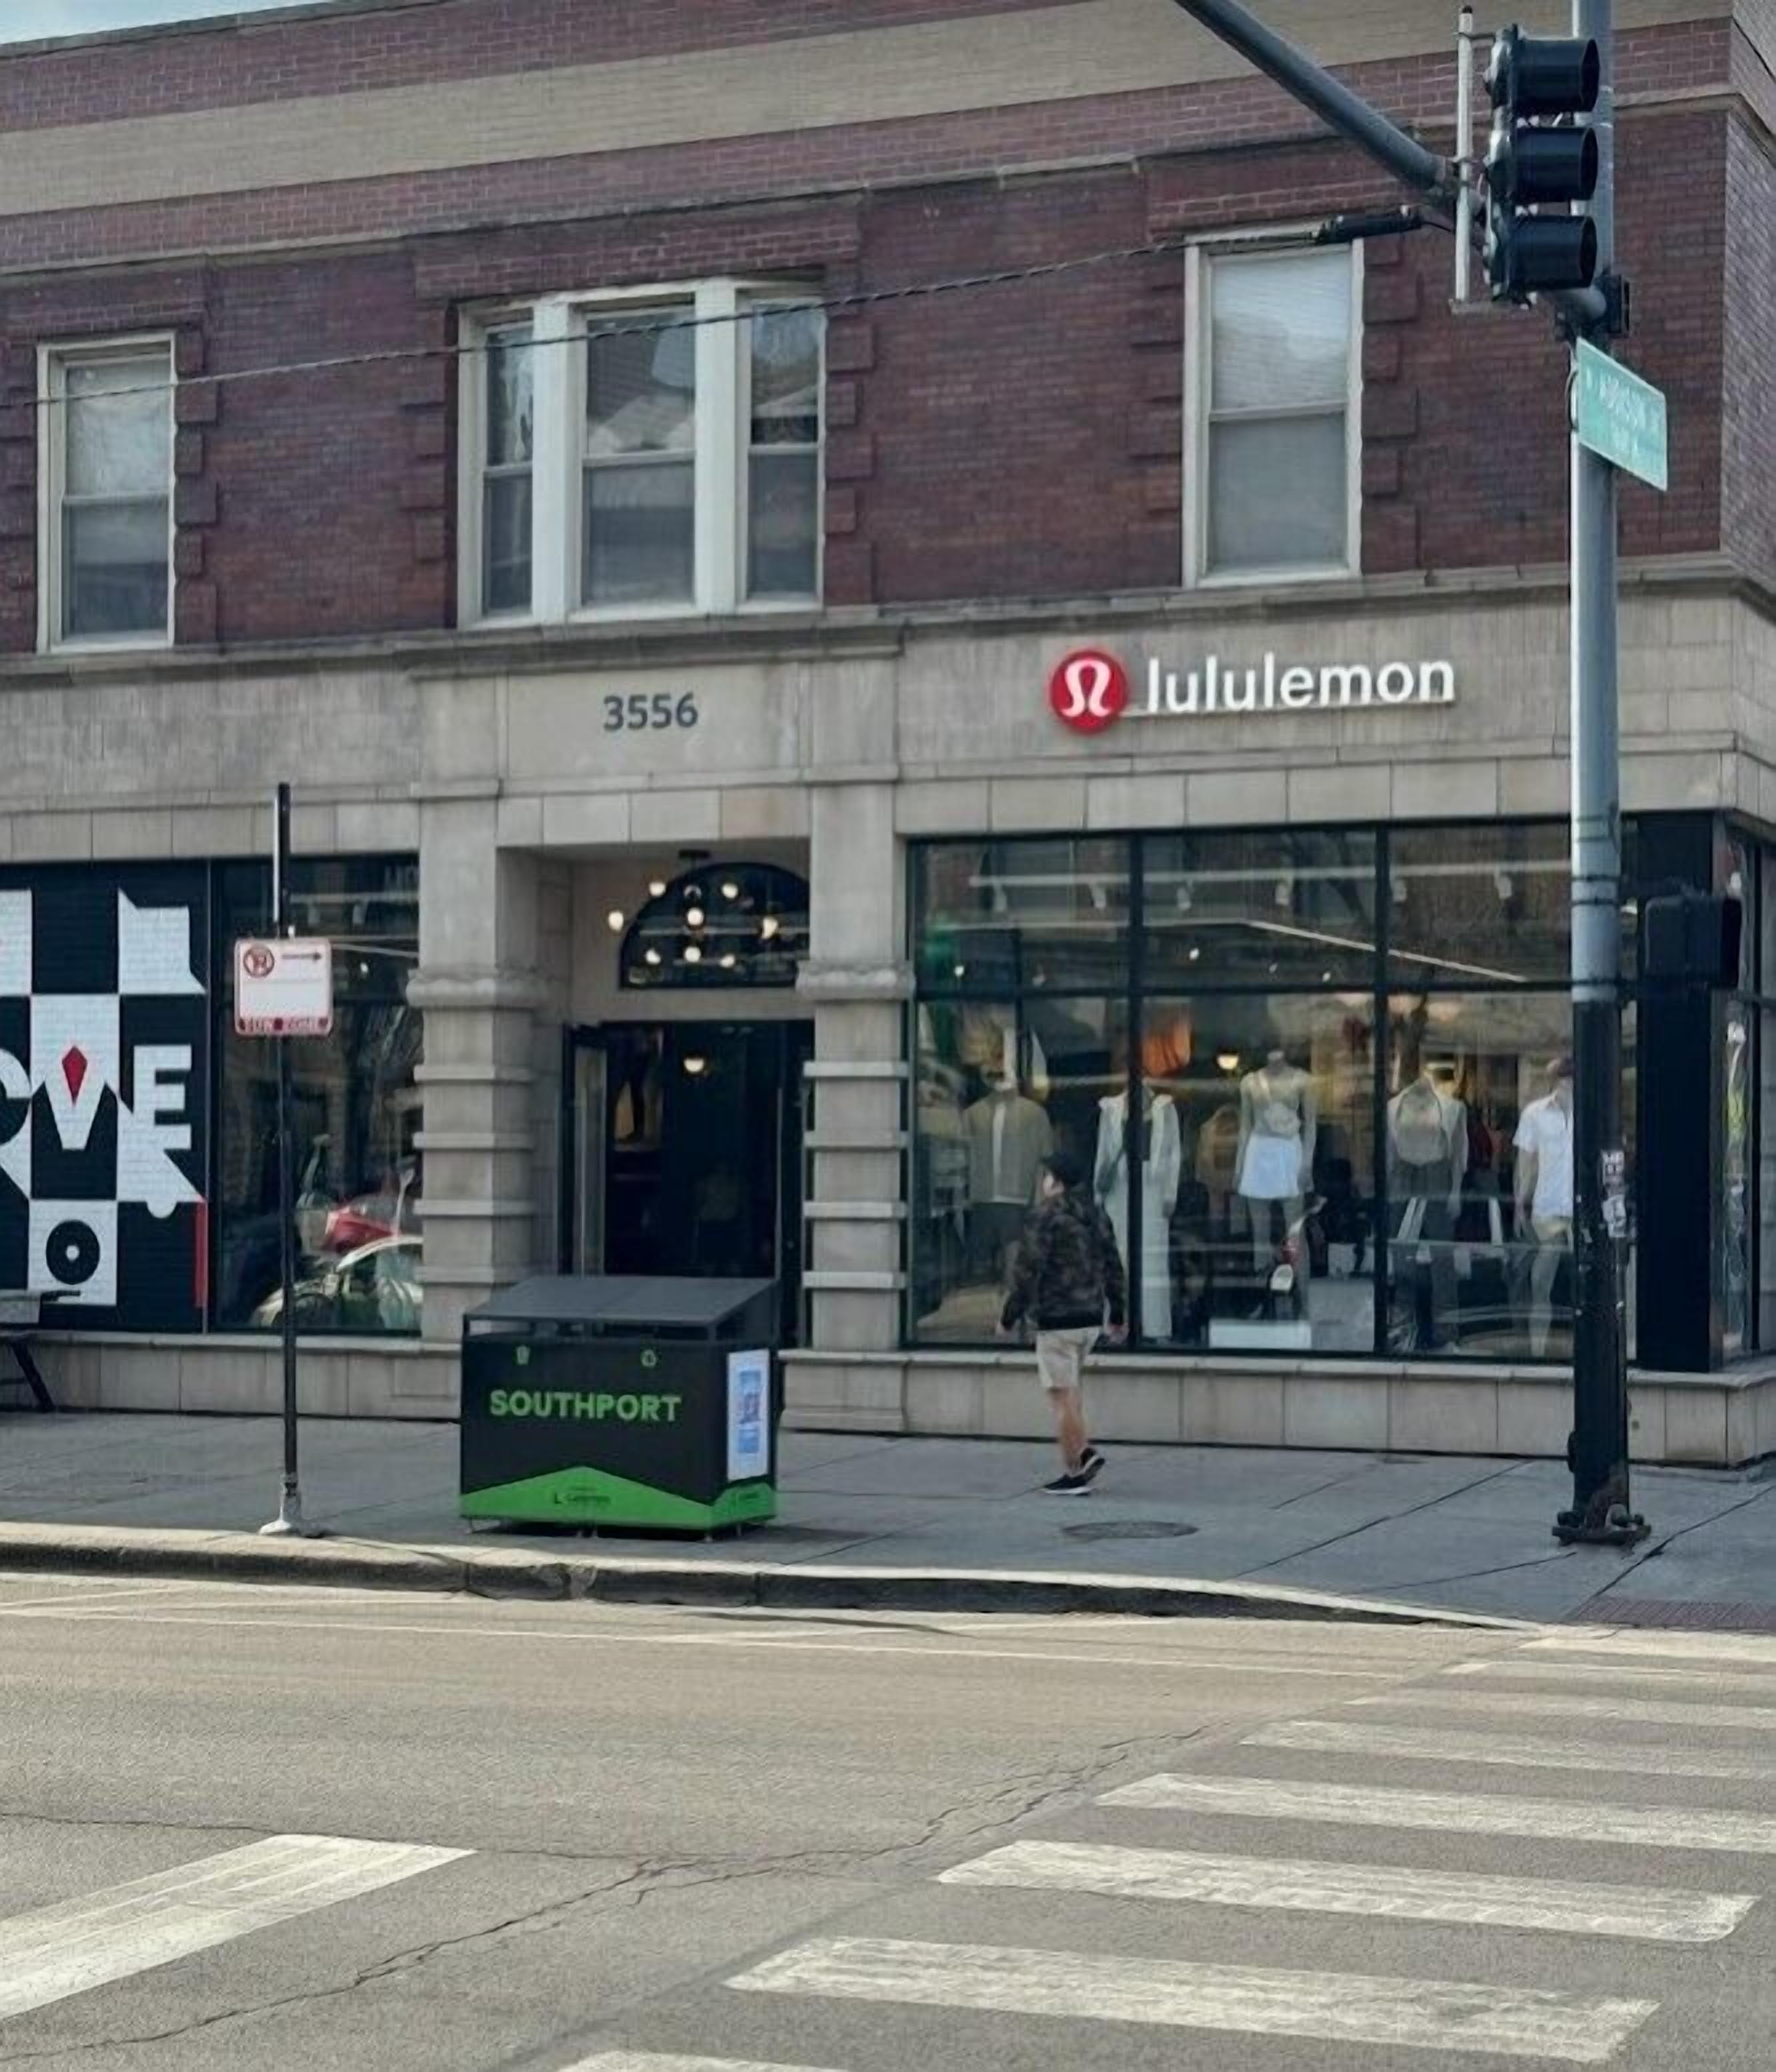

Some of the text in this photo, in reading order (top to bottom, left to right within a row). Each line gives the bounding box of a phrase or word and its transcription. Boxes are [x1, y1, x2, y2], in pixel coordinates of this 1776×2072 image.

[1148, 652, 1455, 713] lululemon
[603, 693, 698, 731] 3556
[490, 1389, 681, 1422] SOUTHPORT
